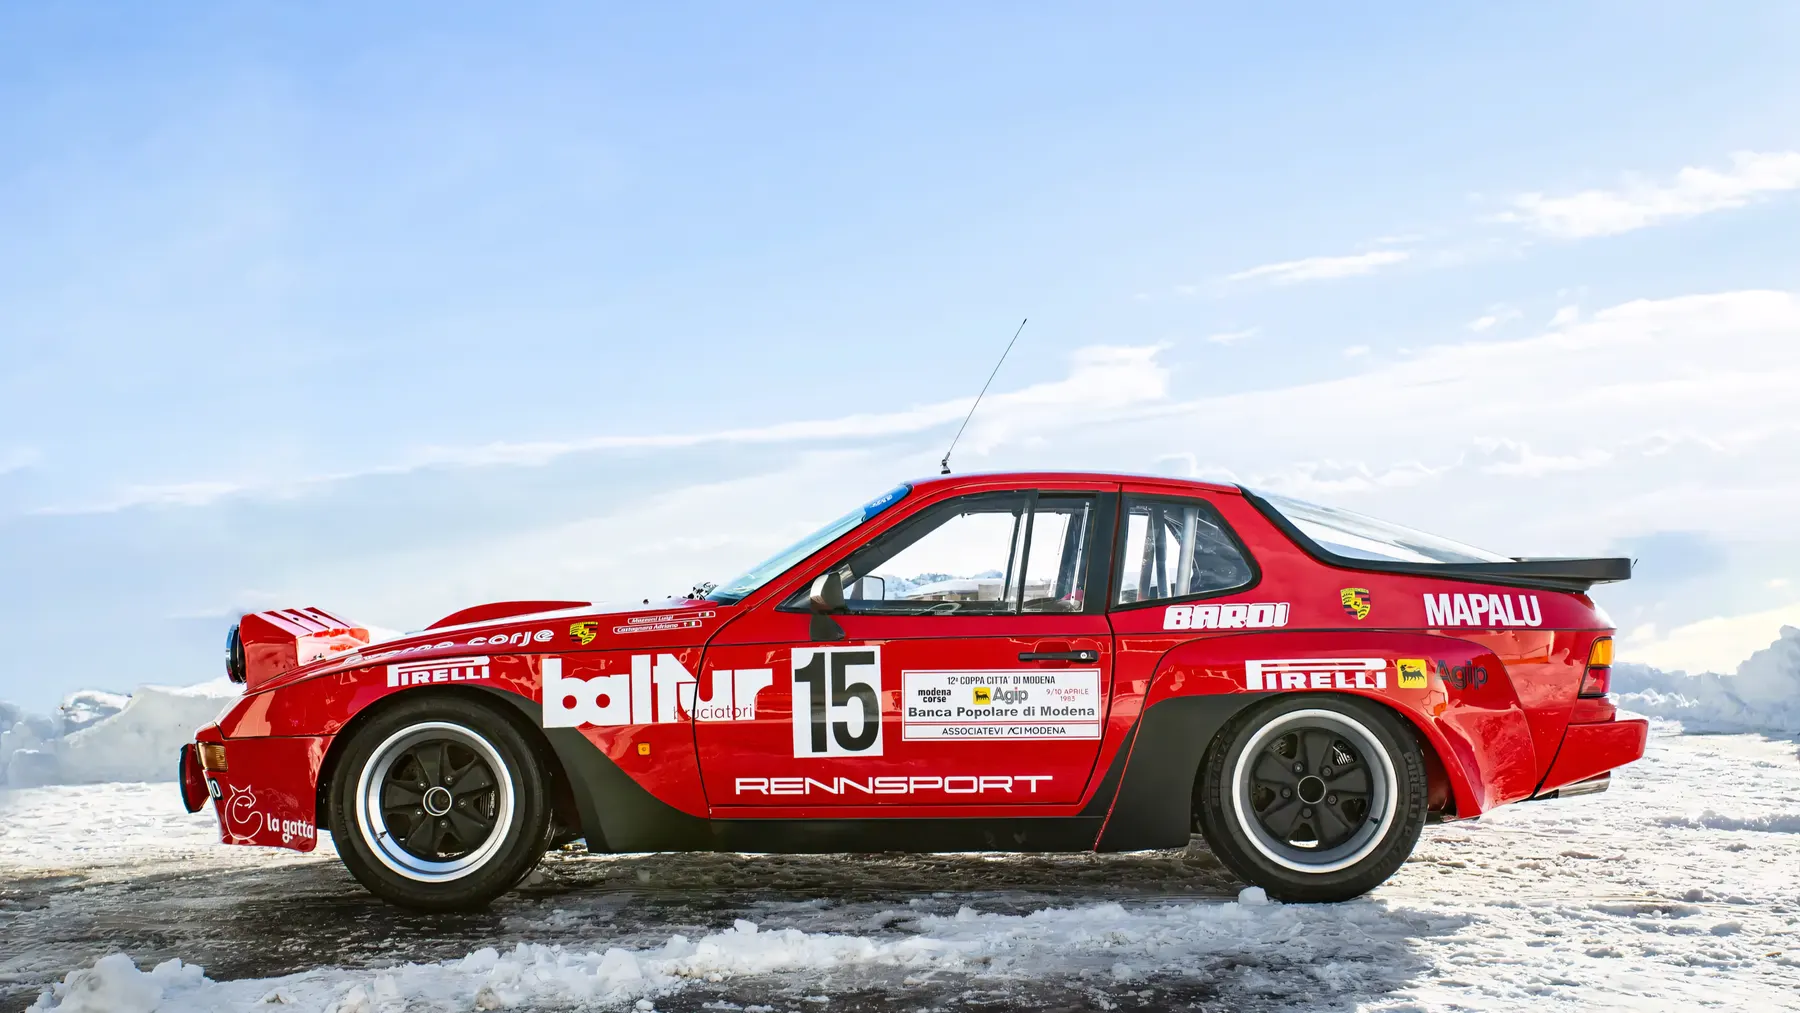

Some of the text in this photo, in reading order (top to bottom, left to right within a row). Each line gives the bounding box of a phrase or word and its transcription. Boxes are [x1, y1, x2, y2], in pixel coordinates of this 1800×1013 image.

[1163, 602, 1290, 630] BARDI
[1423, 593, 1542, 627] MAPALU
[387, 655, 490, 688] PIRELLI
[960, 676, 985, 685] COPPA
[1013, 675, 1021, 684] DI
[1022, 675, 1056, 684] MODENA
[1245, 658, 1387, 690] PIRELLI
[1434, 659, 1488, 691] Agip
[542, 653, 773, 729] baltur
[794, 650, 880, 753] 15
[917, 687, 952, 696] modena
[922, 695, 947, 703] corse
[992, 686, 1029, 705] Agip
[908, 706, 1095, 719] Banca Popolare di Modena
[942, 727, 1003, 736] ASSOCIATEVI
[1026, 726, 1067, 735] MODENA
[736, 775, 1053, 795] RENNSPORT
[266, 812, 280, 833] la
[282, 819, 314, 843] gatta
